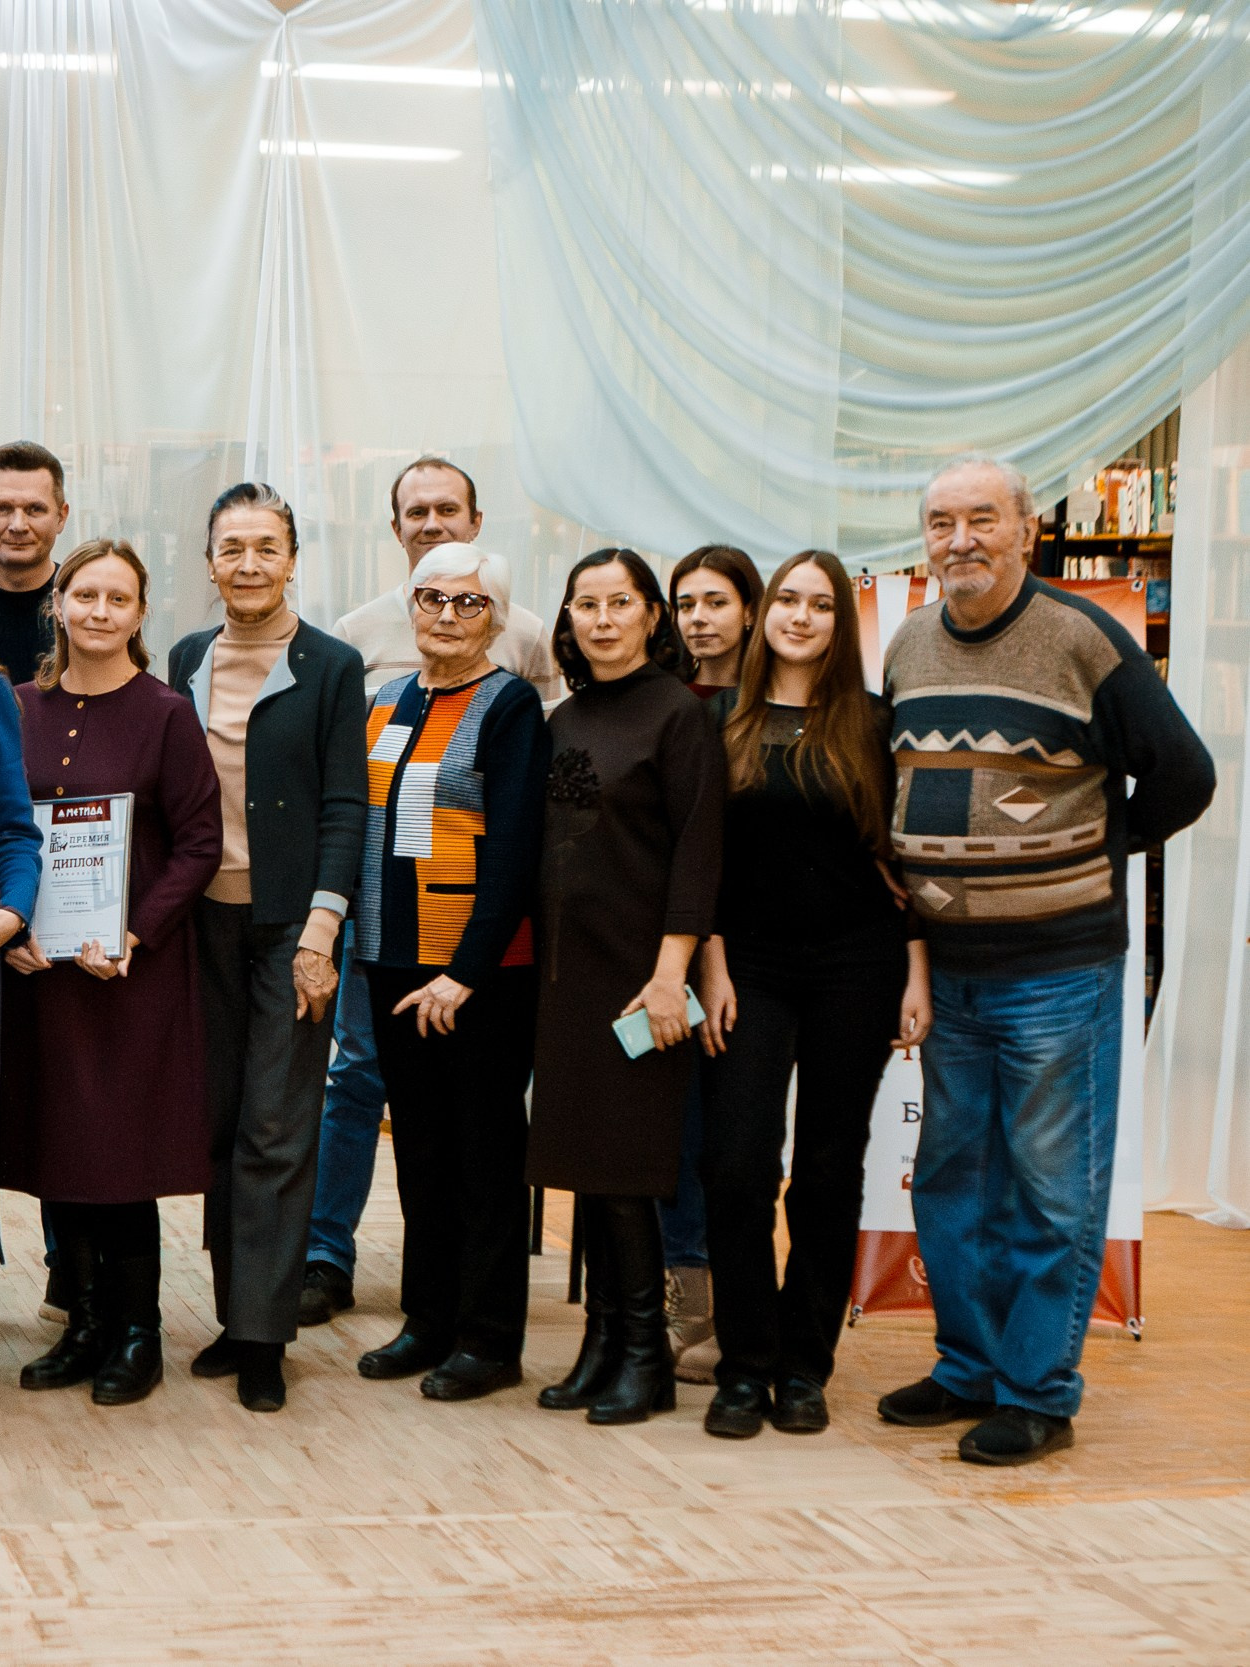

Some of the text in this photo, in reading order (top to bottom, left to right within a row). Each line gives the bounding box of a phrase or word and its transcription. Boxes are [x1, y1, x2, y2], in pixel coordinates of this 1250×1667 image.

[66, 805, 103, 817] МЕТИДА
[70, 834, 109, 844] ПРЕМИЯ
[52, 856, 104, 871] ДИПЛОМ
